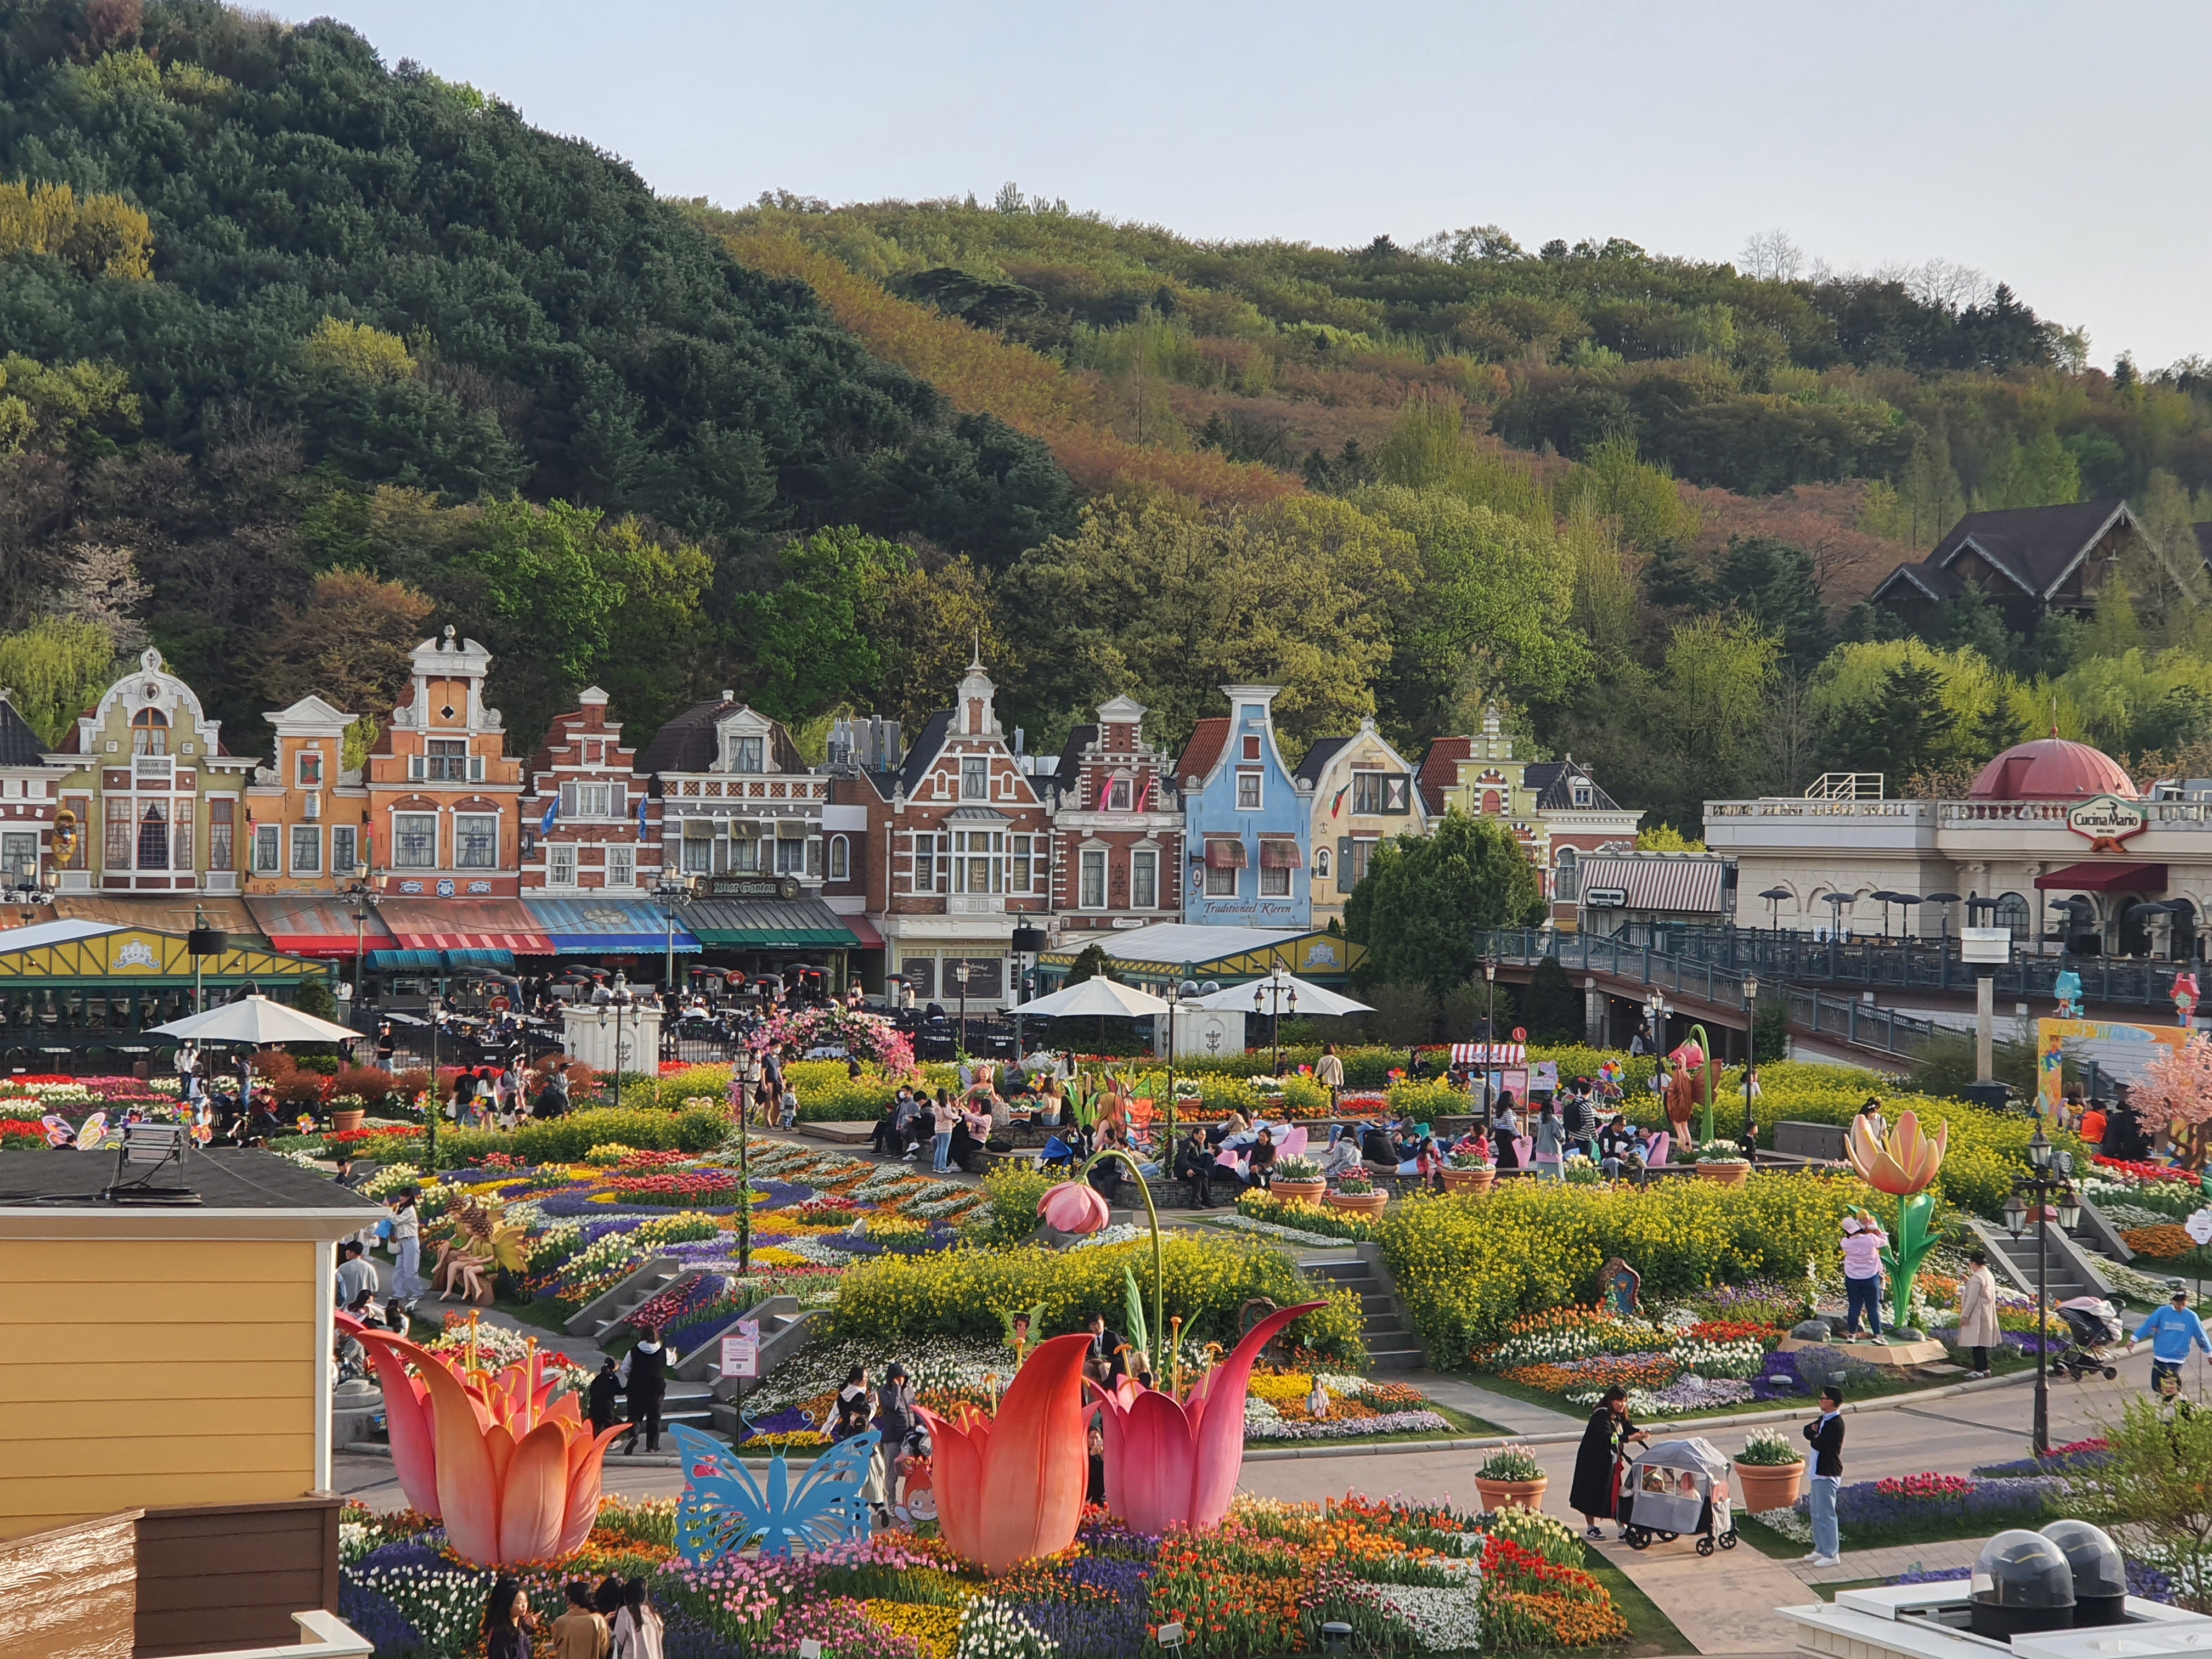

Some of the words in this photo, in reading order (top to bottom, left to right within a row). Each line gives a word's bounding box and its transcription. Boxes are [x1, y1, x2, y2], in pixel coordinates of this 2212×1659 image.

[2074, 812, 2108, 826] Cucina
[2108, 812, 2138, 826] Mario
[714, 882, 740, 893] Bier
[740, 881, 776, 894] Garten
[1204, 901, 1258, 913] Traditioneel
[1260, 902, 1291, 916] Kleren
